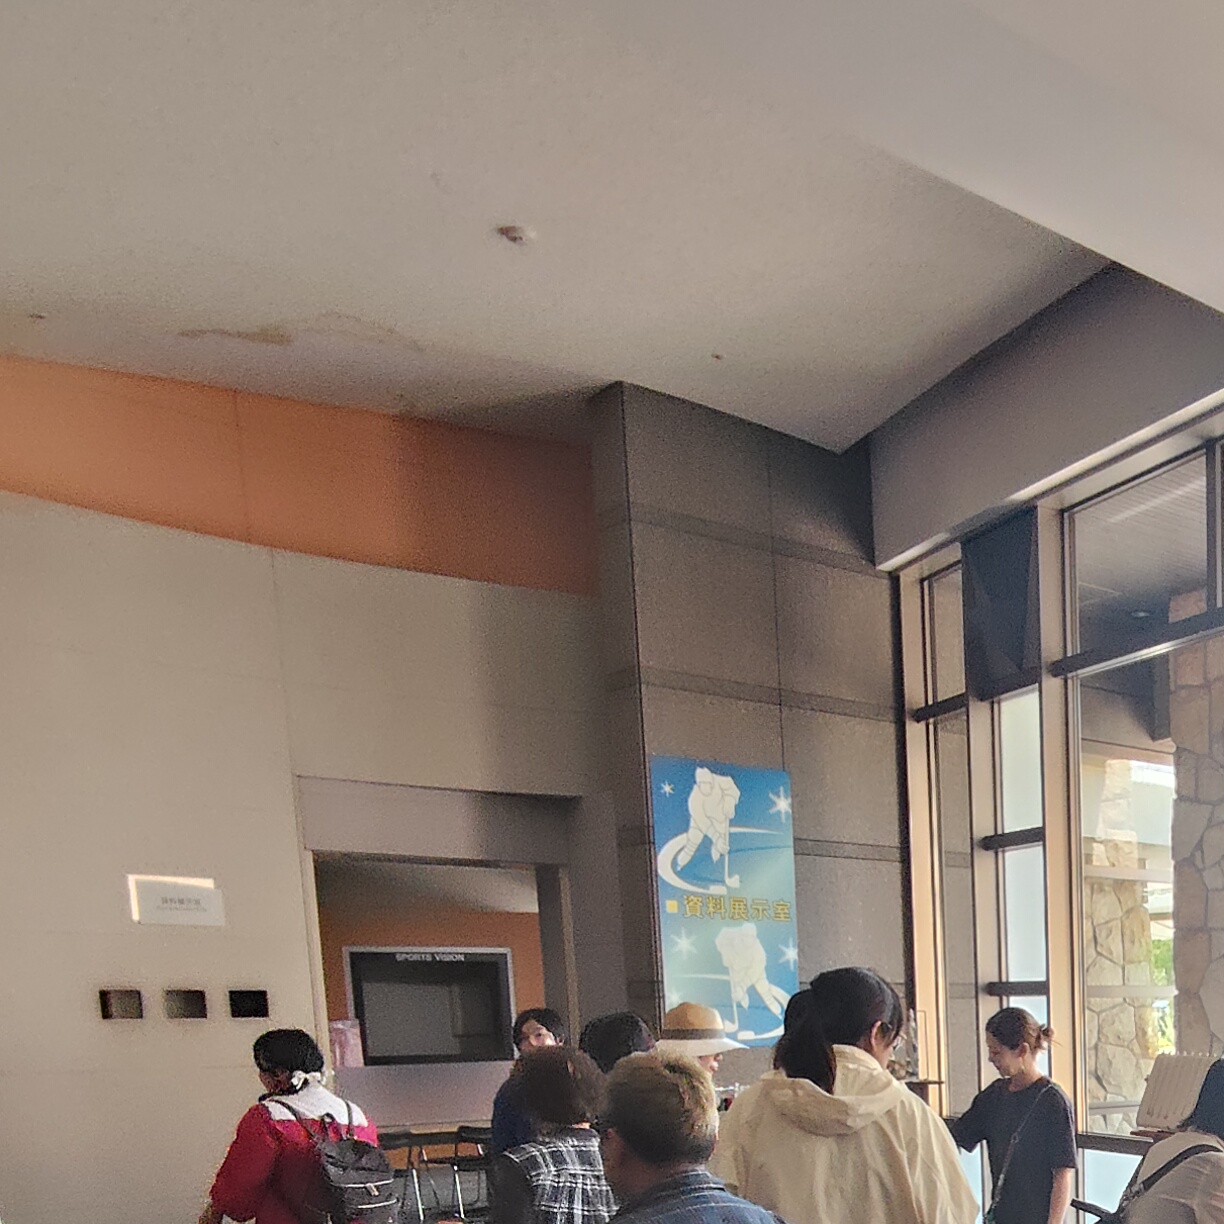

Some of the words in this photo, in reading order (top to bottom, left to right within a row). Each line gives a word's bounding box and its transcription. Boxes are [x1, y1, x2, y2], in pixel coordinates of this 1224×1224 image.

[684, 895, 791, 922] 資料展示室
[396, 953, 432, 962] SPORTS
